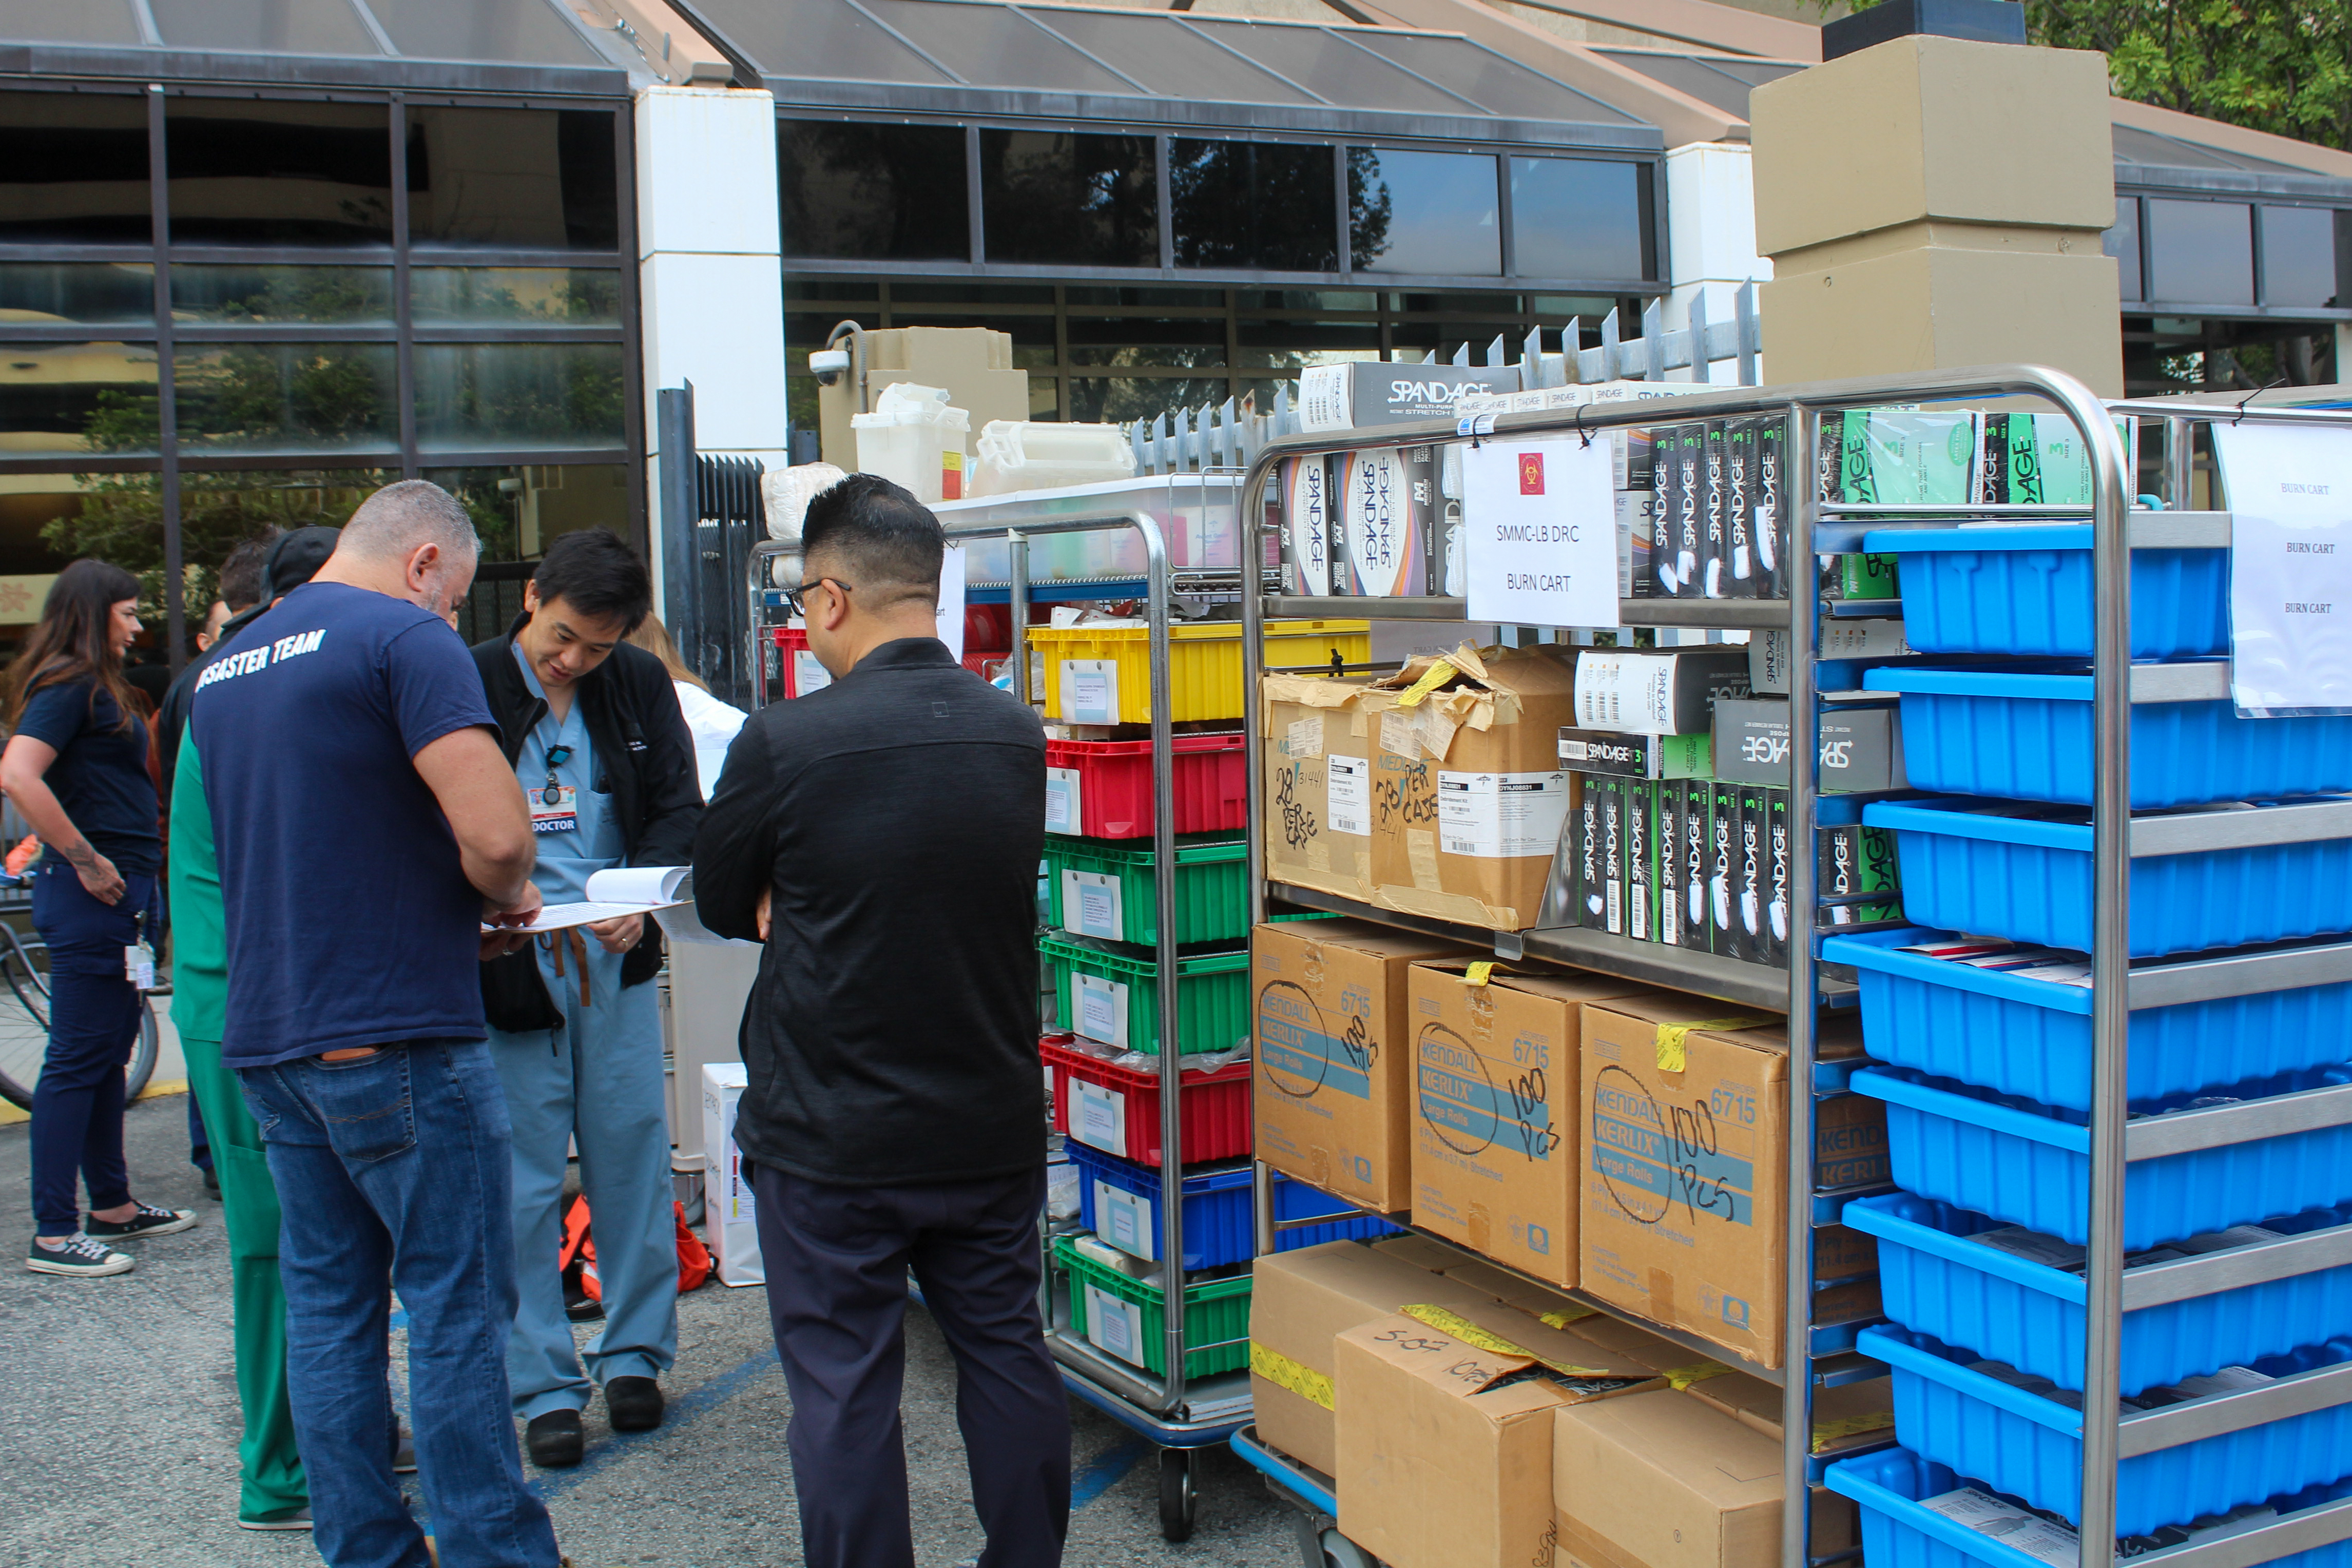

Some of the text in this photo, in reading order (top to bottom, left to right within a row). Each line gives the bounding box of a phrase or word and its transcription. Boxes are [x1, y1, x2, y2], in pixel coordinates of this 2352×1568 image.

[1387, 380, 1490, 404] SPANDAGE
[1710, 431, 1720, 440] 3
[1733, 433, 1743, 442] 3
[1764, 430, 1774, 439] 3
[1822, 425, 1832, 434] 3
[1986, 427, 1997, 436] 3
[1656, 440, 1667, 450] 3
[1684, 437, 1693, 447] 3
[1883, 441, 1899, 454] 3
[2049, 442, 2064, 455] 3
[1708, 454, 1721, 543] SPANDAGE
[2281, 482, 2329, 496] BURN CART
[1654, 462, 1668, 548] SPANDAGE
[1682, 459, 1695, 547] SPANDAGE
[1731, 455, 1745, 545] SPANDAGE
[1307, 466, 1324, 571] SPANDAGE
[1362, 461, 1378, 570] SPANDAGE
[1379, 457, 1391, 569] SPANDAGE
[1497, 525, 1579, 542] SMMC-LB DRC
[2286, 542, 2335, 554] BURN CART
[1508, 573, 1571, 592] BURN CART
[936, 607, 946, 616] art
[2285, 603, 2331, 614] BURN CART
[272, 628, 327, 664] TEAM
[1766, 630, 1776, 684] SPANDAG
[1657, 667, 1667, 726] SPANDAGE
[1588, 743, 1630, 762] SPANDAGE
[1634, 749, 1642, 762] 3
[1378, 754, 1430, 774] MEDLINE
[1276, 768, 1293, 806] 28
[1405, 764, 1429, 805] PER
[1586, 781, 1594, 789] 3
[1607, 783, 1616, 792] 3
[1633, 786, 1642, 795] 3
[1664, 789, 1672, 798] 3
[1690, 792, 1699, 802] 3
[1718, 796, 1727, 805] 3
[1745, 799, 1755, 808] 3
[1774, 802, 1785, 812] 3
[1402, 793, 1438, 824] CASE
[532, 820, 575, 831] DOCTOR
[1584, 801, 1596, 882] SPANDAGE
[1606, 802, 1618, 879] SPANDAGE
[1631, 806, 1644, 883] SPANDAGE
[1662, 811, 1674, 887] SPANDAGE
[1347, 982, 1371, 995] REORDER
[1262, 993, 1311, 1023] KENDALL
[1341, 990, 1371, 1018] 6715
[1520, 1029, 1549, 1044] REORDER
[1264, 1047, 1303, 1070] Large Rolls
[1422, 1041, 1477, 1074] KENDALL
[1514, 1037, 1549, 1069] 6715
[1594, 1042, 1621, 1058] STERILE
[1508, 1067, 1546, 1120] 100
[1720, 1078, 1757, 1095] REORDER
[1422, 1099, 1469, 1127] Large Rolls
[1596, 1086, 1665, 1126] KENDALL
[1710, 1088, 1756, 1125] 6715
[1669, 1099, 1717, 1163] 100
[1821, 1125, 1887, 1155] KEND
[1470, 1160, 1503, 1183] Stretched
[1596, 1154, 1653, 1184] Large Rolls
[1597, 1183, 1610, 1200] Ply
[1609, 1206, 1621, 1217] cm
[1654, 1222, 1694, 1248] Stretched
[1962, 1489, 2008, 1509] SPANDAGE
[2041, 1523, 2078, 1541] MULTI-PURP
